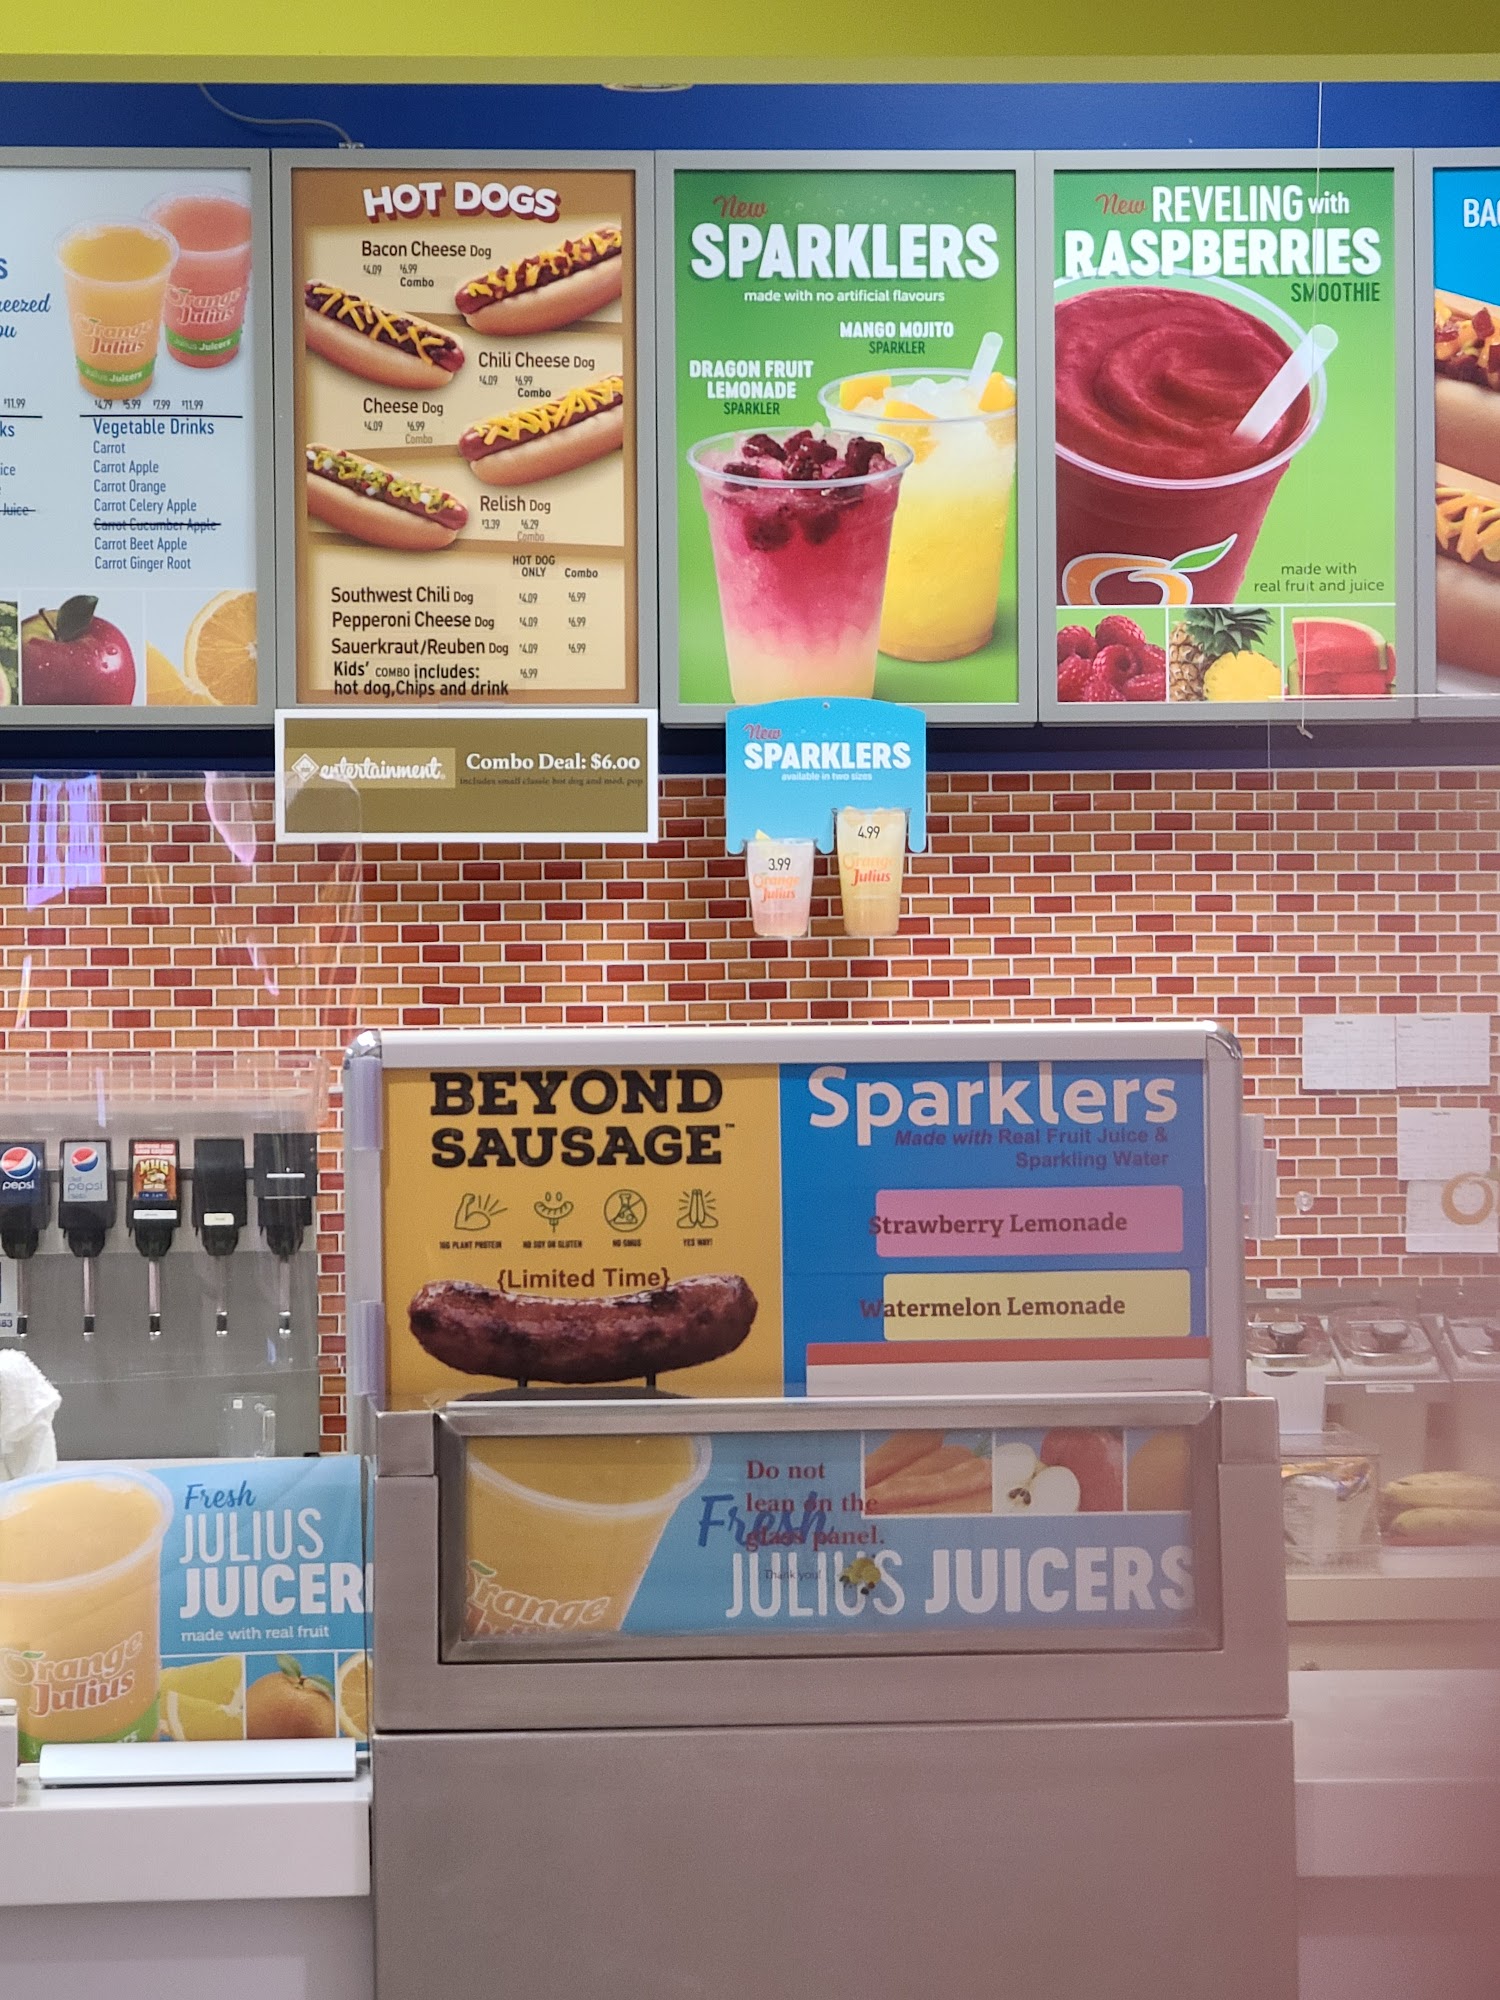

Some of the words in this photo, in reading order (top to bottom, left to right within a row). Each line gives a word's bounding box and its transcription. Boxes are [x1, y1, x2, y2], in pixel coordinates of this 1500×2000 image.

[363, 182, 445, 221] HOT
[454, 182, 561, 221] DOGS
[713, 195, 767, 219] New
[1094, 192, 1147, 216] New
[1152, 185, 1303, 223] REVELING
[1307, 190, 1351, 216] with
[362, 240, 407, 257] Bacon
[411, 241, 466, 257] Cheese
[470, 245, 492, 260] Dog
[690, 222, 1000, 280] SPARKLERS
[1063, 226, 1382, 280] RASPBERRIES
[400, 277, 435, 288] Combo
[1290, 282, 1381, 302] SMOOTHIE
[0, 293, 51, 313] eezed
[744, 290, 781, 302] made
[784, 289, 813, 302] with
[816, 292, 834, 302] no
[837, 289, 889, 302] artificial
[892, 289, 945, 302] flavours
[839, 321, 896, 338] MANGO
[899, 320, 954, 338] MOJITO
[869, 340, 925, 354] SPARKLER
[478, 351, 511, 368] Chili
[515, 351, 570, 368] Cheese
[573, 356, 595, 371] Dog
[689, 359, 761, 379] DRAGON
[765, 359, 814, 378] FRUIT
[517, 387, 551, 398] Combo
[707, 381, 797, 400] LEMONADE
[363, 397, 419, 414] Cheese
[422, 401, 444, 417] Dog
[723, 401, 781, 416] SPARKLER
[93, 417, 165, 438] Vegetable
[170, 417, 215, 435] Drinks
[93, 440, 126, 454] Carrot
[405, 433, 433, 445] Combo
[93, 459, 126, 473] Carrot
[129, 459, 159, 476] Apple
[93, 479, 126, 492] Carrot
[129, 479, 166, 495] Orange
[94, 498, 126, 511] Carrot
[129, 498, 163, 514] Celery
[166, 498, 197, 514] Apple
[480, 495, 526, 512] Relish
[529, 499, 551, 515] Dog
[94, 517, 126, 531] Carrot
[130, 517, 183, 531] Cucumber
[187, 517, 217, 534] Apple
[94, 536, 127, 550] Carrot
[130, 536, 154, 550] Beet
[157, 536, 188, 553] Apple
[95, 556, 127, 570] Carrot
[130, 556, 163, 572] Ginger
[167, 556, 191, 570] Root
[512, 555, 531, 566] HOT
[535, 555, 556, 566] DOG
[1281, 563, 1321, 575] made
[1325, 562, 1357, 575] with
[521, 567, 546, 578] ONLY
[564, 568, 598, 578] Combo
[331, 586, 413, 603] Southwest
[416, 585, 450, 603] Chili
[454, 591, 474, 605] Dog
[1254, 579, 1281, 592] real
[1285, 579, 1315, 592] fruit
[1319, 579, 1346, 592] and
[1349, 579, 1385, 594] juice
[332, 611, 410, 632] Pepperoni
[414, 611, 471, 627] Cheese
[475, 616, 495, 630] Dog
[331, 637, 485, 656] Sauerkraut/Reuben
[489, 642, 509, 656] Dog
[375, 667, 410, 678] COMBO
[414, 664, 480, 679] includes:
[334, 680, 358, 695] hot
[440, 681, 466, 696] and
[471, 680, 509, 696] drink
[743, 724, 782, 740] New
[466, 753, 534, 770] Combo
[538, 753, 586, 770] Deal:
[590, 752, 641, 770] $6.00
[743, 742, 912, 770] SPARKLERS
[857, 825, 880, 839] 4.99
[768, 857, 791, 871] 3.99
[851, 868, 891, 887] Julius
[761, 887, 796, 903] Julius
[430, 1069, 723, 1116] BEYOND
[808, 1062, 1178, 1146] Sparklers
[895, 1129, 946, 1147] Made
[953, 1128, 992, 1146] with
[998, 1128, 1040, 1144] Real
[1046, 1127, 1091, 1144] Fruit
[1096, 1127, 1148, 1143] Juice
[1155, 1127, 1168, 1143] &
[139, 1158, 169, 1175] MUG
[1015, 1151, 1107, 1171] Sparkling
[1113, 1151, 1169, 1168] Water
[2, 1180, 35, 1192] pepsi
[67, 1180, 103, 1193] pepsi
[868, 1214, 1004, 1238] Strawberry
[1009, 1212, 1128, 1234] Lemonade
[497, 1268, 595, 1294] {Limited
[602, 1267, 670, 1292] Time}
[858, 1297, 1001, 1318] Watermelon
[1006, 1295, 1126, 1317] Lemonade
[746, 1459, 780, 1479] Do
[788, 1462, 826, 1479] not
[184, 1481, 256, 1509] Fresh
[746, 1492, 795, 1512] lean
[803, 1497, 832, 1512] on
[841, 1492, 878, 1512] the
[698, 1491, 834, 1547] Fresh
[179, 1507, 325, 1565] JULIUS
[746, 1525, 804, 1552] glass
[812, 1525, 885, 1551] panel.
[725, 1550, 905, 1618] JULIUS
[925, 1546, 1196, 1614] JUICERS
[181, 1628, 224, 1642] made
[228, 1627, 262, 1641] with
[265, 1626, 294, 1639] real
[298, 1625, 330, 1638] fruit
[1, 1631, 143, 1685] Orange
[28, 1669, 135, 1718] Julius
